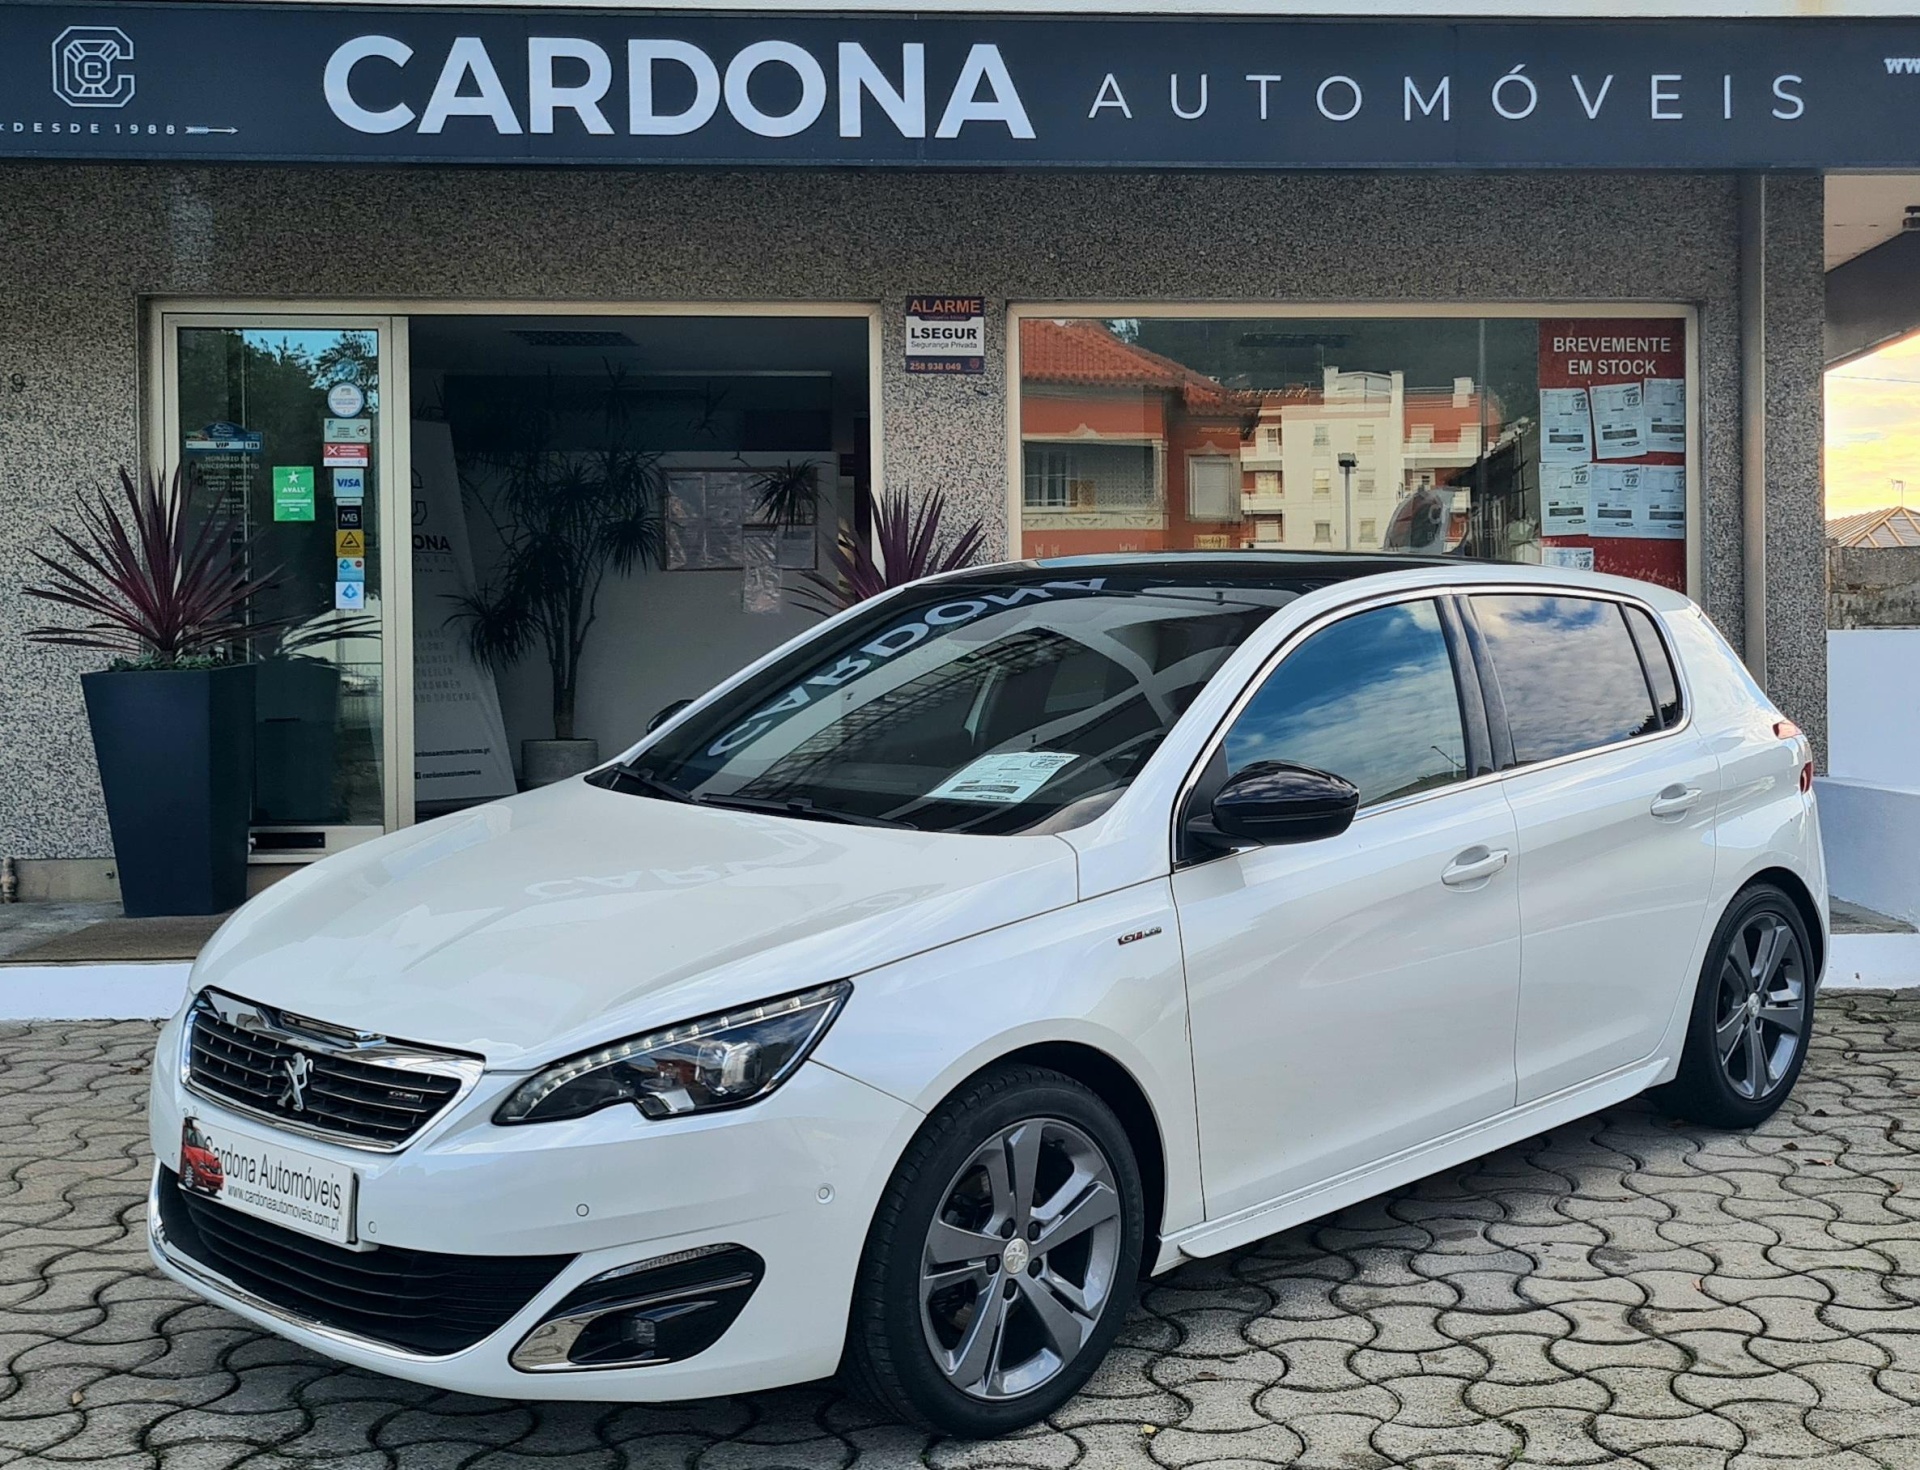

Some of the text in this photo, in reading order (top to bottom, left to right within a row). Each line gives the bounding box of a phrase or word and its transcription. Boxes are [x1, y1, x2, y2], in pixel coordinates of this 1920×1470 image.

[324, 36, 1804, 138] CARDONA AUTOMÓVEIS
[13, 122, 176, 135] DESDE 1988
[910, 300, 981, 313] ALARME
[911, 327, 978, 340] LSEGUR
[911, 341, 978, 350] Segurança Privada
[1553, 337, 1671, 352] BREVEMENTE
[910, 363, 926, 371] 258
[945, 363, 962, 371] 049
[1568, 359, 1657, 375] EM STOCK
[336, 478, 361, 488] VISA
[340, 511, 358, 523] MB
[258, 1153, 342, 1211] Automóveis
[227, 1184, 341, 1233] www.cardonaautomoveis.com.pt
